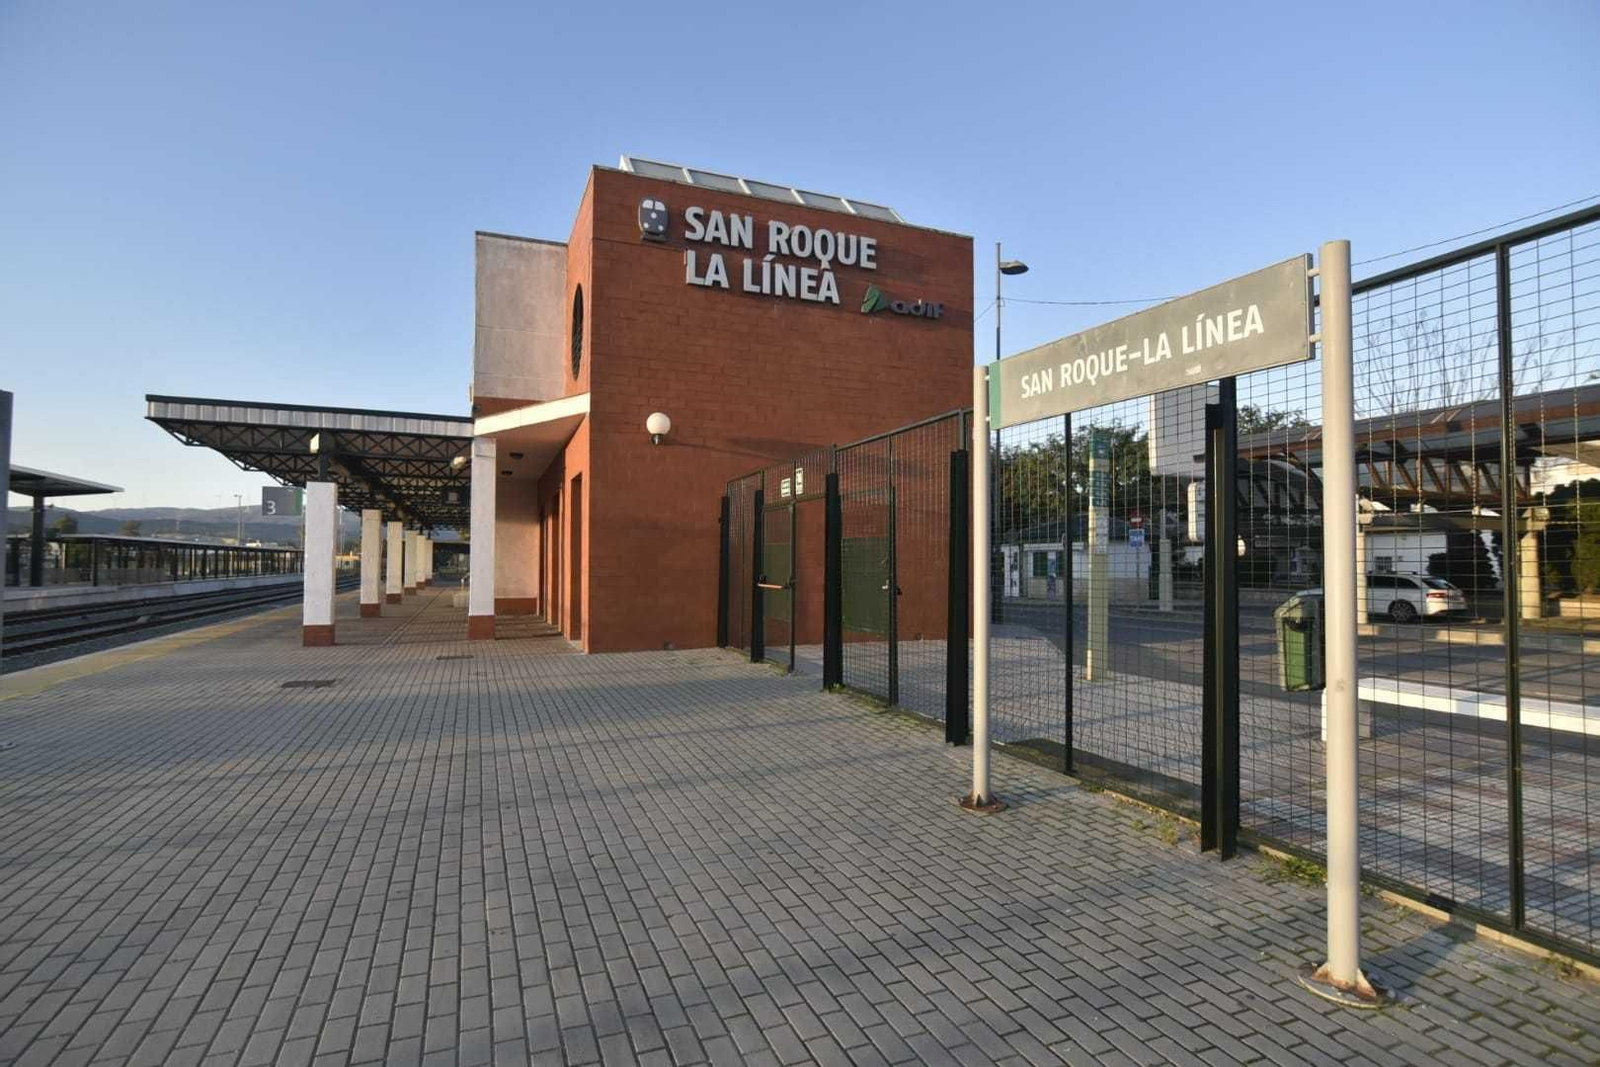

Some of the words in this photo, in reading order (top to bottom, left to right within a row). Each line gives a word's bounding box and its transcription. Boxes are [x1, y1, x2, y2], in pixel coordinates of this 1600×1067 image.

[684, 205, 754, 250] SAN
[768, 220, 877, 269] ROQUE
[685, 248, 730, 289] LA
[743, 255, 840, 304] LÍNEA
[1020, 367, 1054, 400] SAN
[1181, 303, 1265, 355] LÍNEA
[267, 500, 276, 515] 3
